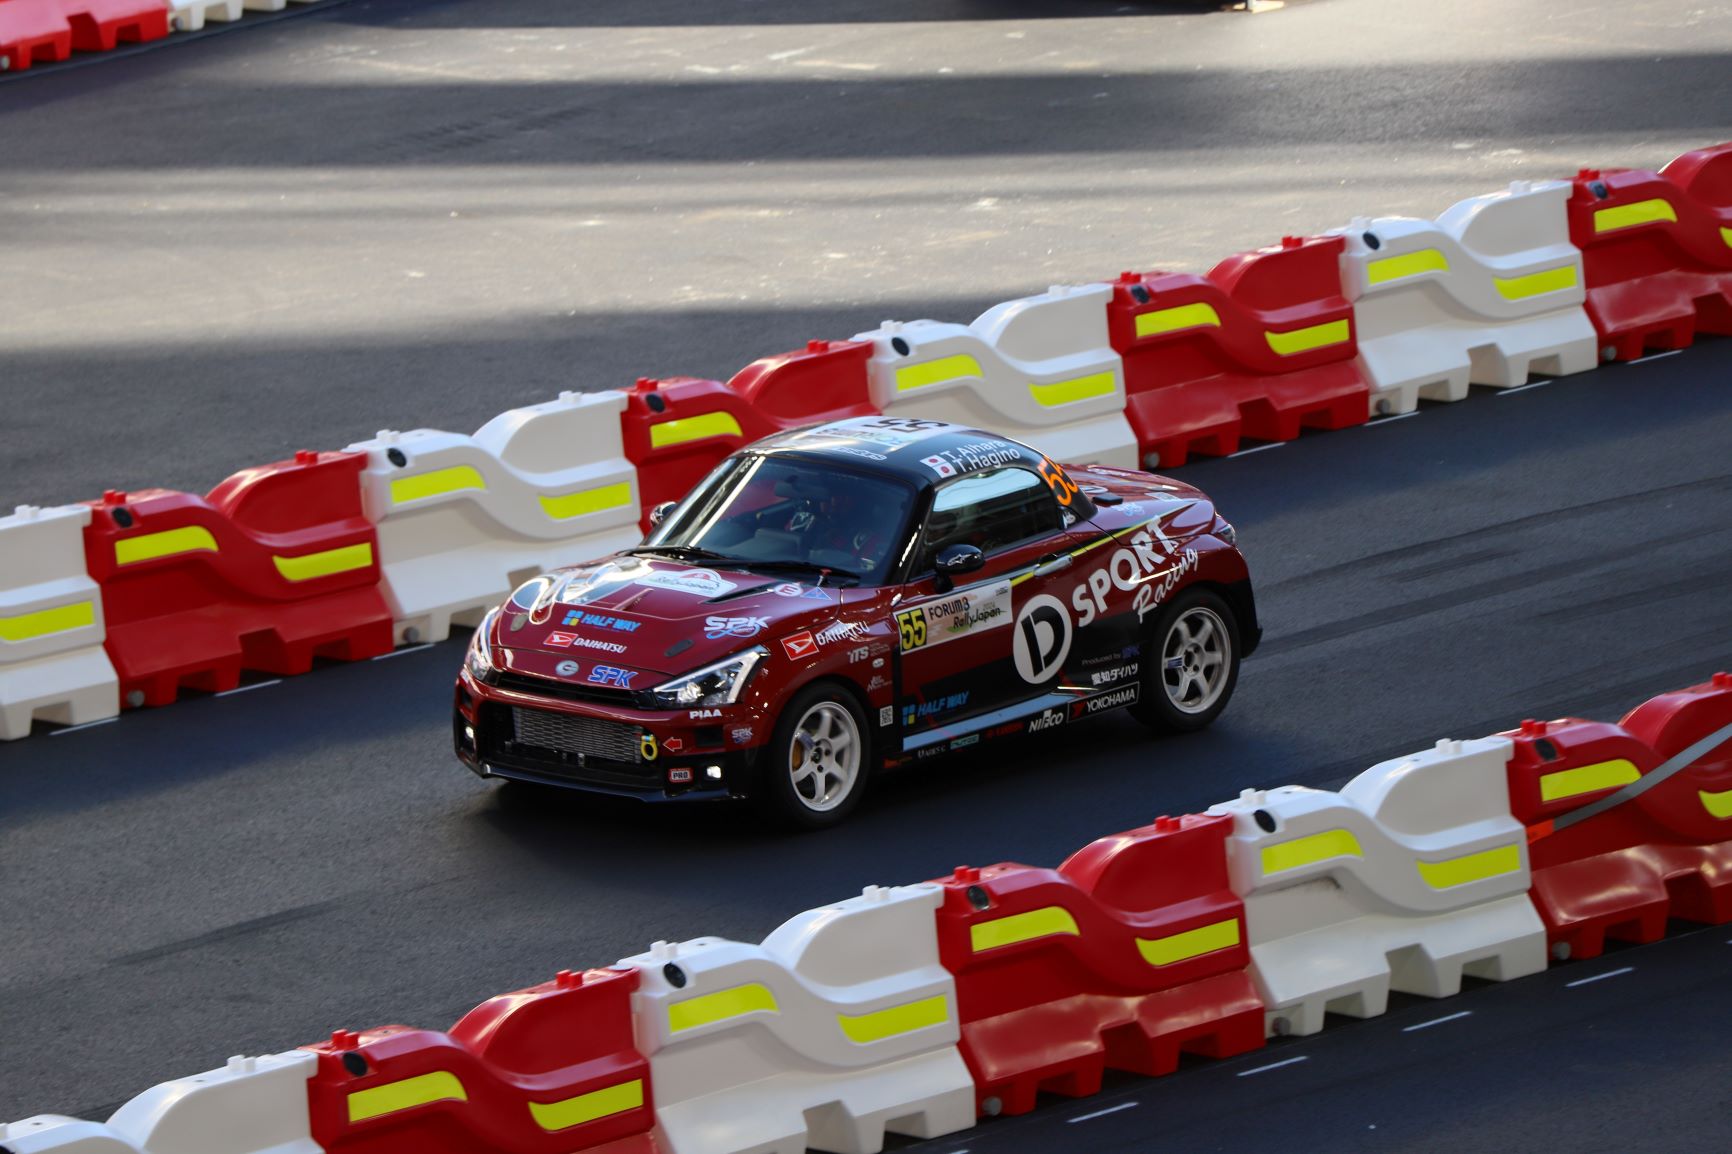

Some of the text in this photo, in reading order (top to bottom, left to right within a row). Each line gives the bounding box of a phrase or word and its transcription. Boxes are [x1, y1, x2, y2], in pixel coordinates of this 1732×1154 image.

[1072, 515, 1179, 627] SPORT
[1132, 547, 1198, 625] Racing
[581, 614, 615, 628] HALF
[612, 618, 642, 632] WAY
[703, 616, 773, 637] SPK
[815, 620, 871, 646] DAIHATSU
[897, 609, 927, 651] 55
[573, 636, 628, 654] DAIHATSU
[587, 664, 638, 688] SPK
[916, 690, 970, 717] HALF WAY
[1086, 688, 1136, 712] YOKOHAMA
[689, 708, 723, 720] PIAA
